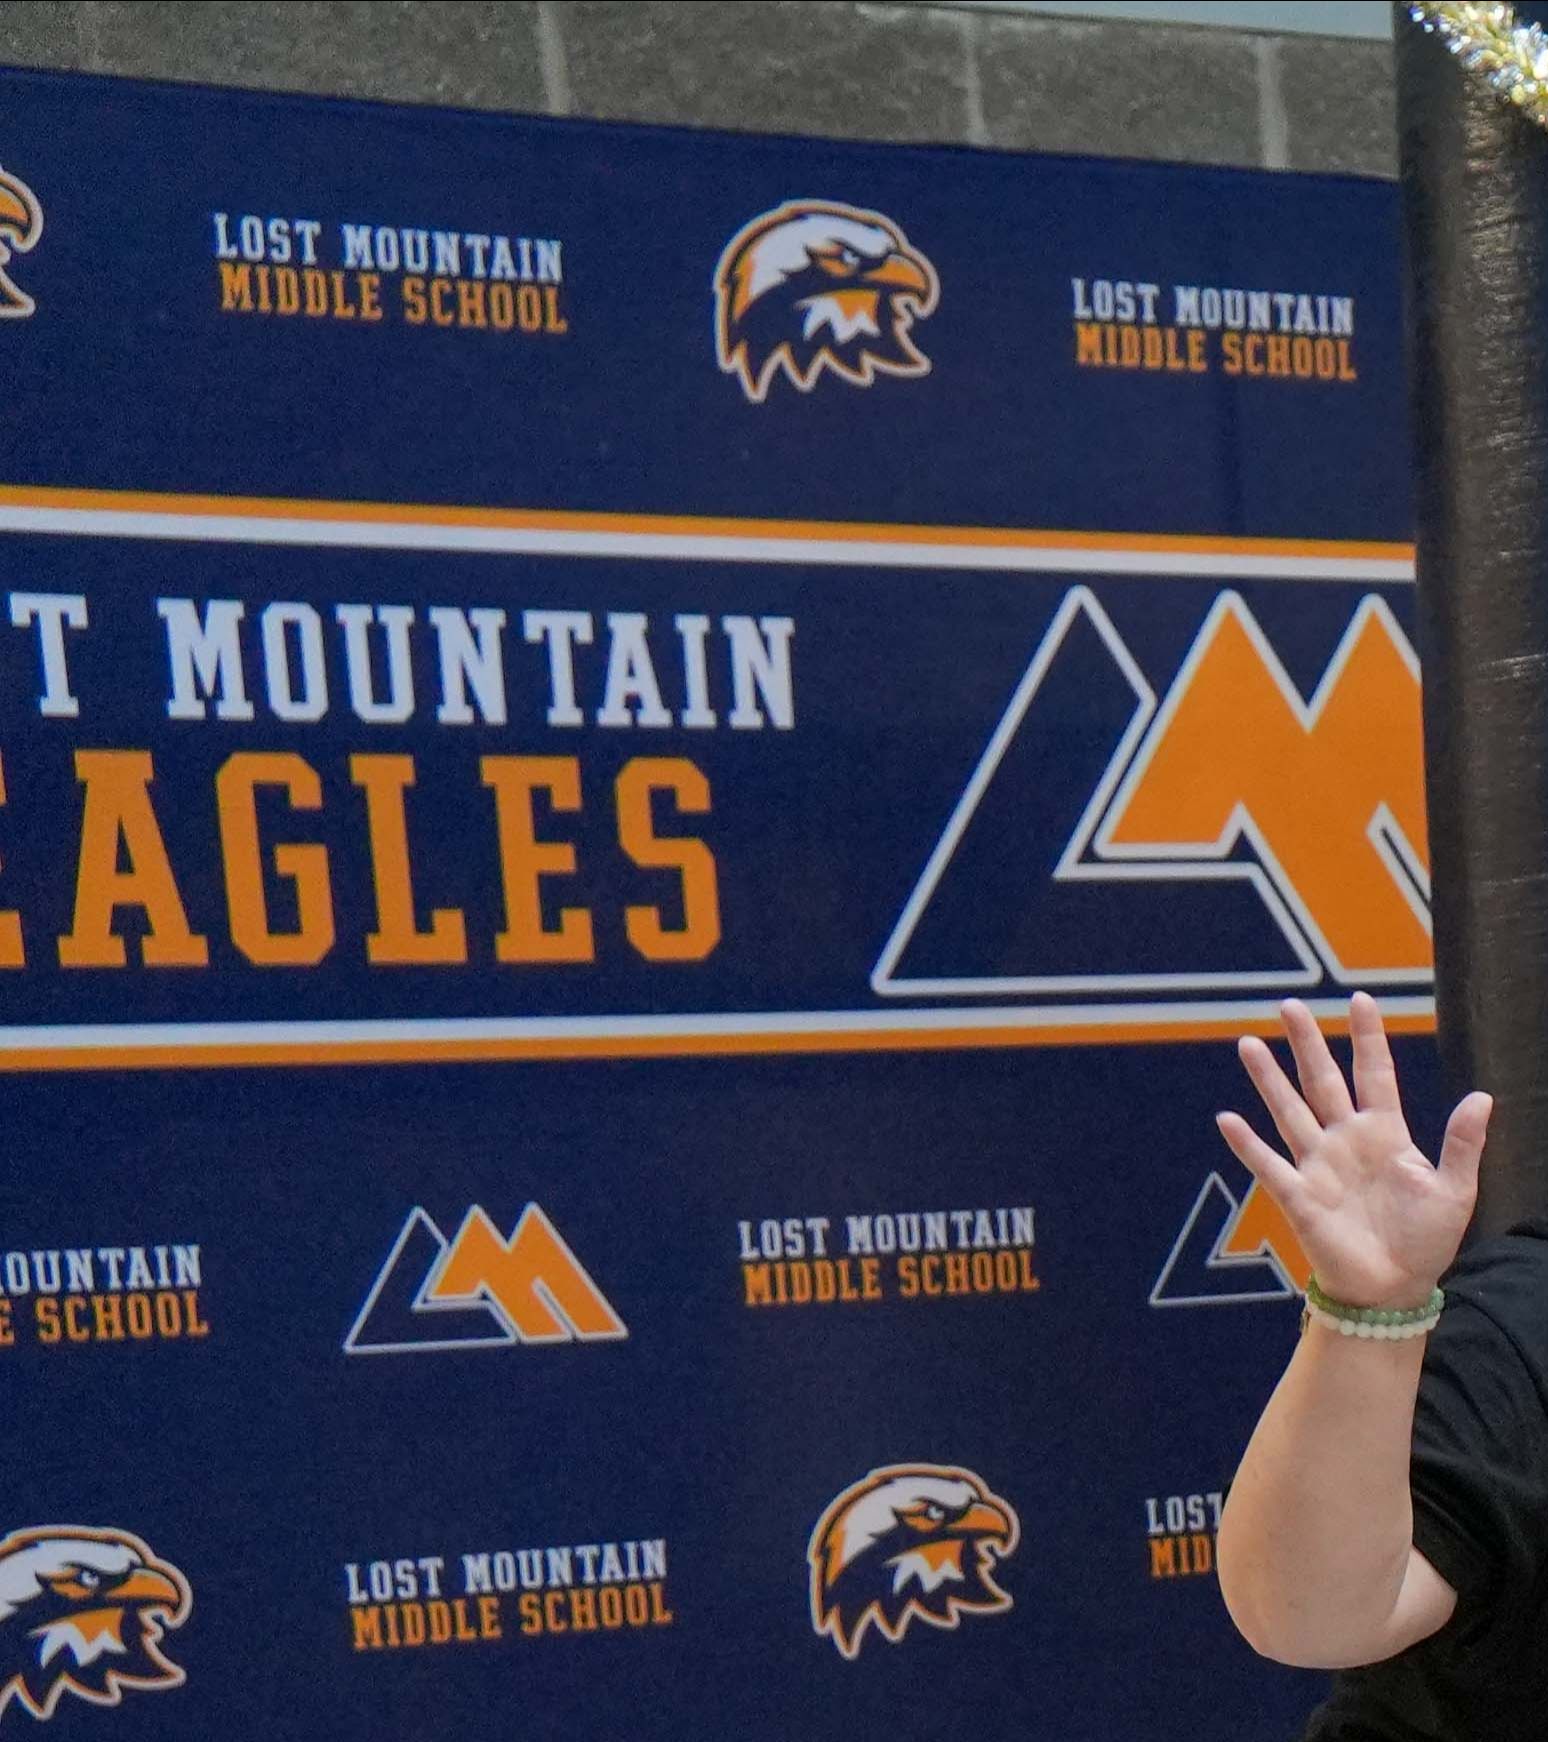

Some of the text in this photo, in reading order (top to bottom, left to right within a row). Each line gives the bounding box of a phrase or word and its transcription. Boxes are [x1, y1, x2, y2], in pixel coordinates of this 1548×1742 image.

[214, 212, 564, 286] LOST MOUNTAIN
[221, 263, 567, 333] MIDDLE SCHOOL
[1074, 279, 1355, 338] LOST MOUNTAIN
[1077, 324, 1356, 381] MIDDLE SCHOOL
[161, 601, 797, 731] MOUNTAIN
[0, 751, 722, 969] AGLES
[738, 1208, 1036, 1262] LOST MOUNTAIN
[0, 1246, 203, 1297] OUNTAIN
[744, 1251, 1041, 1306] MIDDLE SCHOOL
[36, 1292, 209, 1342] SCHOOL
[1147, 1493, 1222, 1536] LOST
[346, 1539, 670, 1606] LOST MOUNTAIN
[1152, 1536, 1213, 1578] MID
[352, 1584, 673, 1650] MIDDLE SCHOOL
